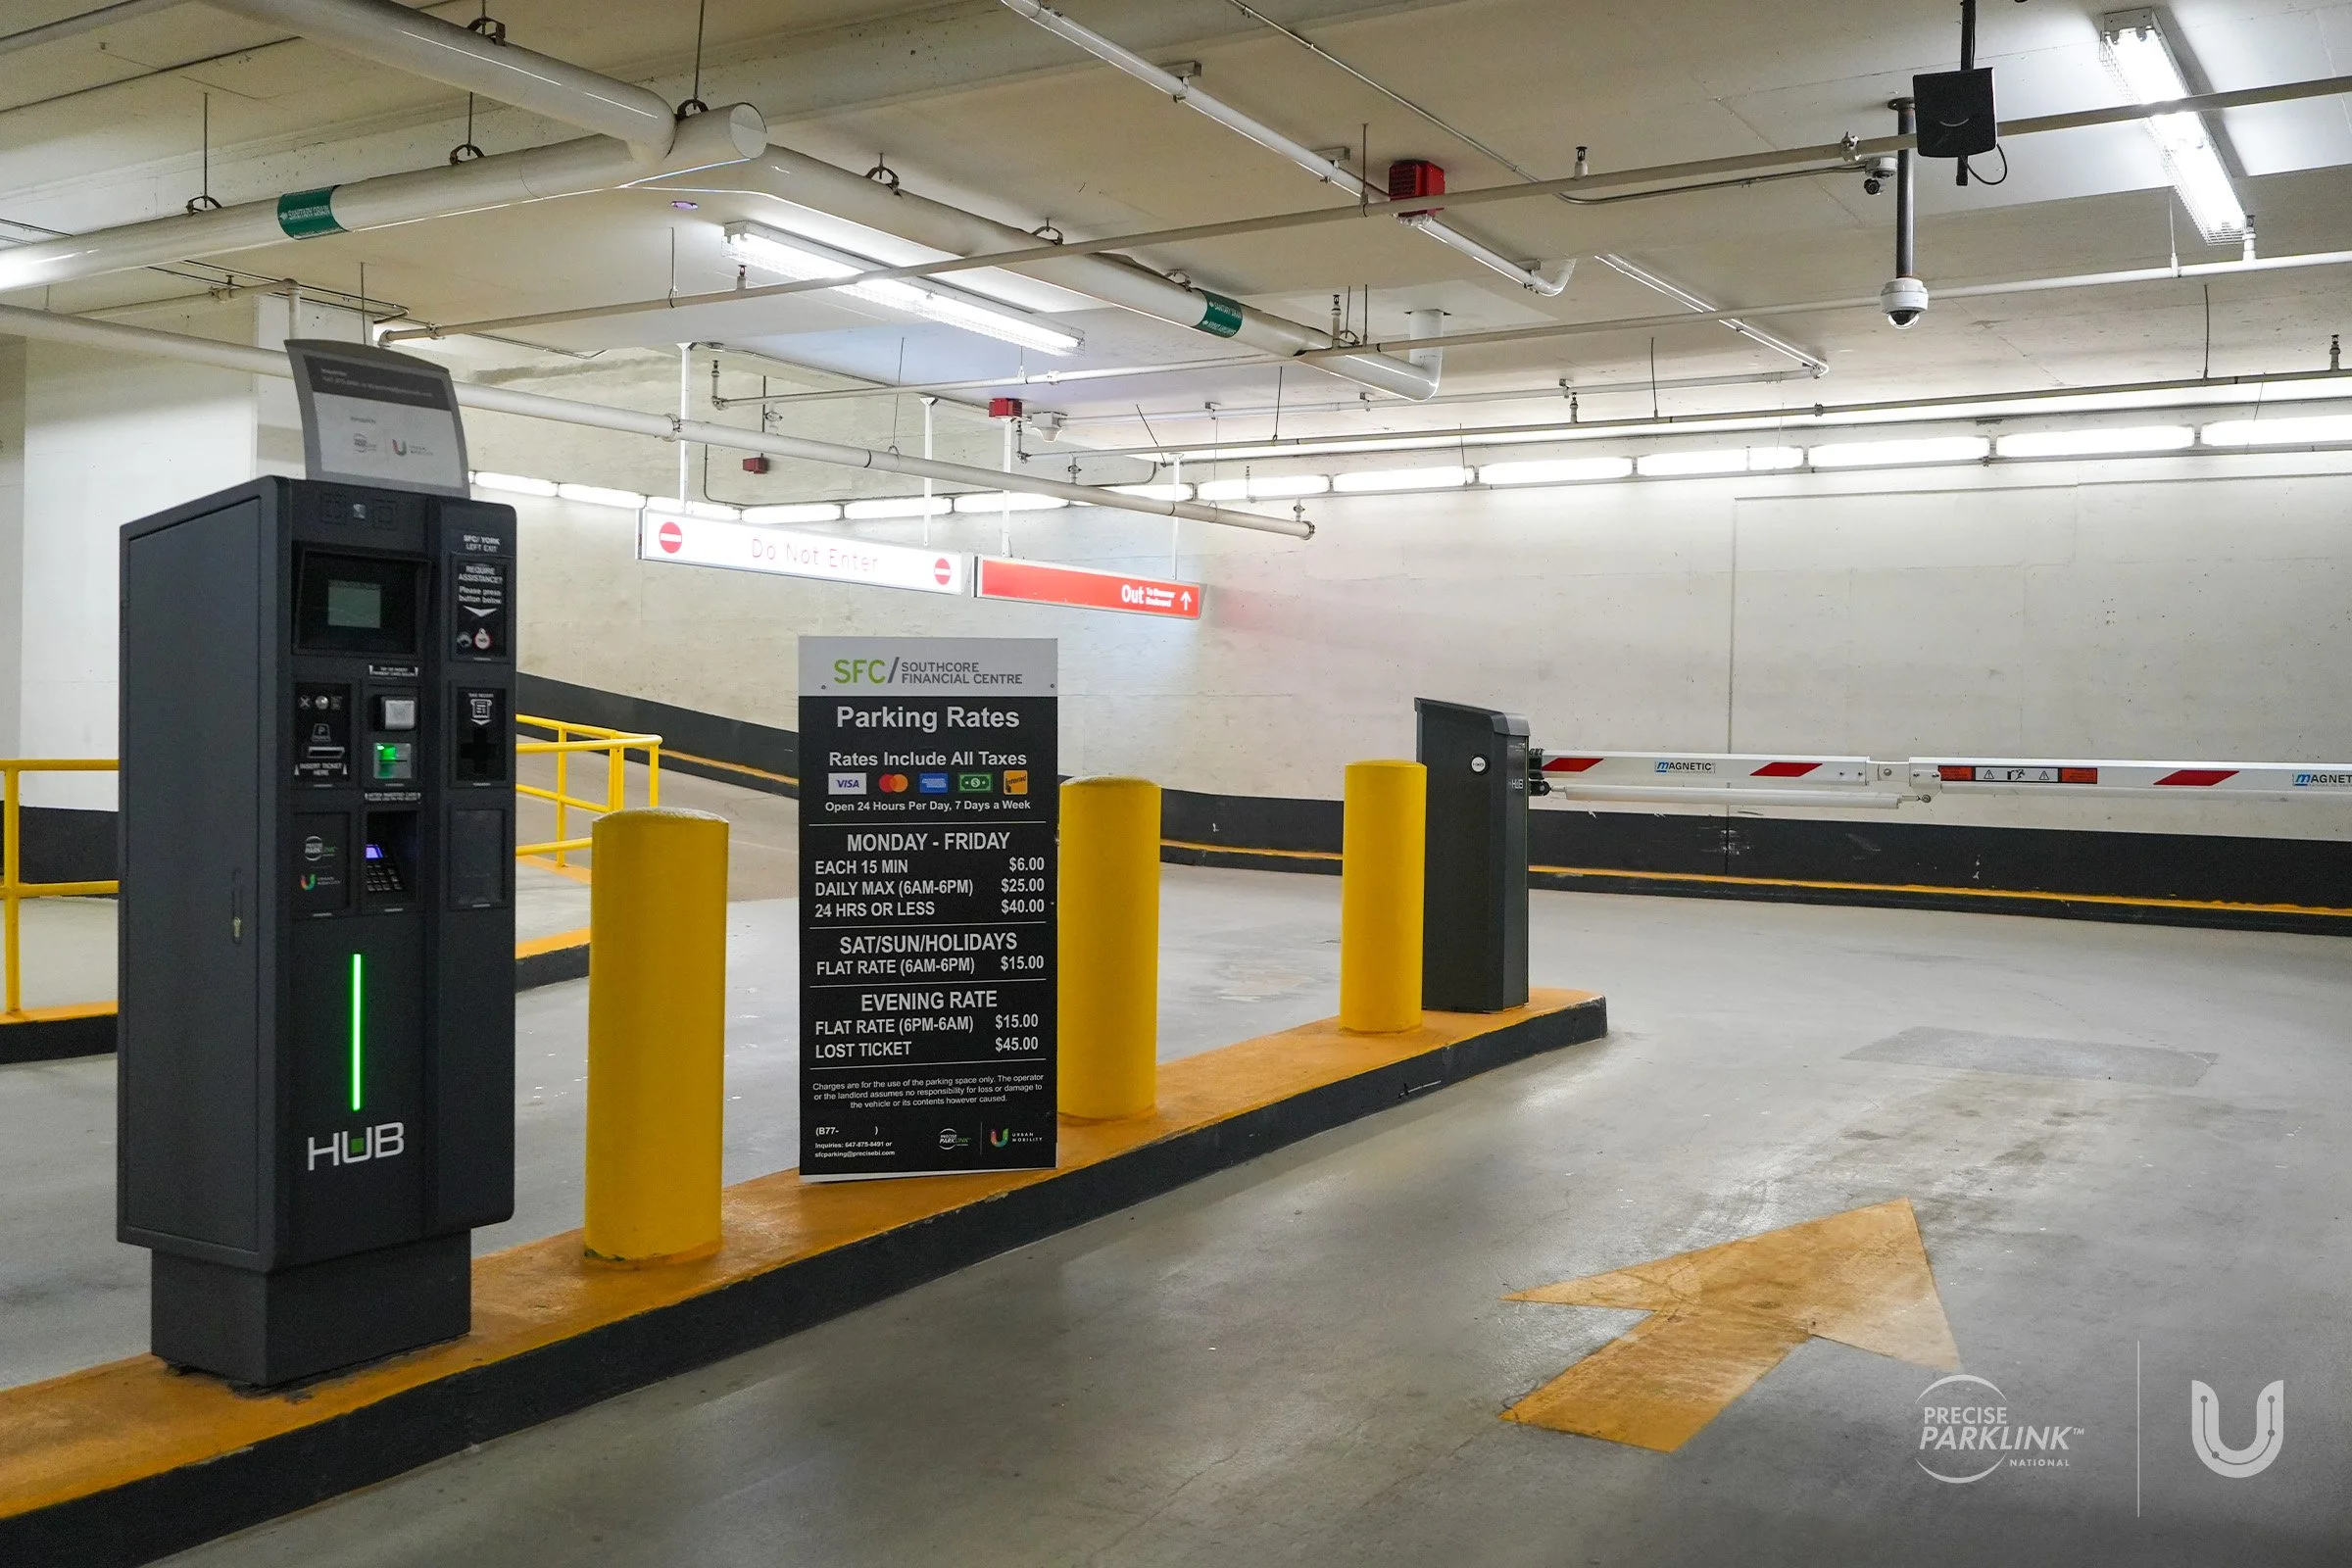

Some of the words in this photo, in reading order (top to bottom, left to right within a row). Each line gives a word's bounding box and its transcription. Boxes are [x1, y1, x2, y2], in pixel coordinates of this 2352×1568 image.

[752, 538, 776, 561] Do
[787, 543, 819, 565] Not
[829, 548, 878, 571] Enter
[466, 565, 495, 575] REQUIRE
[459, 585, 481, 595] Please
[1121, 583, 1145, 605] Out
[902, 662, 979, 673] SOUTHCORE
[902, 673, 969, 684] FINANCIAL
[973, 673, 1023, 684] CENTRE
[837, 706, 938, 734] Parking
[947, 706, 1020, 729] Rates
[829, 752, 878, 766] Rates
[884, 751, 947, 766] Include
[951, 751, 973, 765] All
[978, 751, 1027, 765] Taxes
[836, 779, 859, 789] VISA
[825, 802, 855, 812] Open
[858, 802, 870, 811] 24
[873, 801, 906, 810] Hours
[908, 801, 927, 810] Per
[929, 801, 953, 812] Day,
[956, 801, 960, 810] 7
[963, 801, 990, 812] Days
[1002, 800, 1031, 809] Week
[847, 833, 928, 852] MONDAY
[945, 832, 1010, 851] FRIDAY
[814, 860, 857, 875] EACH
[861, 859, 877, 874] 15
[882, 859, 908, 873] MIN
[1009, 857, 1045, 872] $6.00
[815, 882, 858, 897] DAILY
[861, 881, 895, 896] MAX
[899, 879, 973, 898] (6AM-6PM)
[1001, 877, 1045, 894] $25.00
[814, 904, 832, 918] 24
[836, 903, 867, 917] HRS
[870, 903, 893, 916] OR
[898, 902, 935, 916] LESS
[1001, 899, 1045, 914] $40.00
[840, 932, 1017, 955] SAT/SUN/HOLIDAYS
[816, 960, 853, 976] FLAT
[858, 959, 896, 974] RATE
[900, 957, 975, 977] (6AM-6PM)
[1001, 955, 1045, 971] $15.00
[861, 992, 944, 1012] EVENING
[950, 990, 998, 1009] RATE
[815, 1021, 853, 1036] FLAT
[857, 1019, 895, 1034] RATE
[899, 1016, 974, 1036] (6PM-6AM)
[995, 1013, 1039, 1030] $15.00
[815, 1044, 855, 1058] LOST
[858, 1042, 912, 1057] TICKET
[995, 1036, 1039, 1053] $45.00
[812, 1083, 845, 1092] Charges
[926, 1078, 953, 1087] parking
[979, 1076, 996, 1085] only.
[1013, 1074, 1044, 1083] operator
[838, 1091, 868, 1100] landlord
[917, 1086, 964, 1097] responsibility
[1004, 1084, 1034, 1093] damage
[864, 1100, 891, 1108] vehicle
[912, 1098, 945, 1106] contents
[979, 1095, 1007, 1103] caused.
[308, 1121, 405, 1171] HUB
